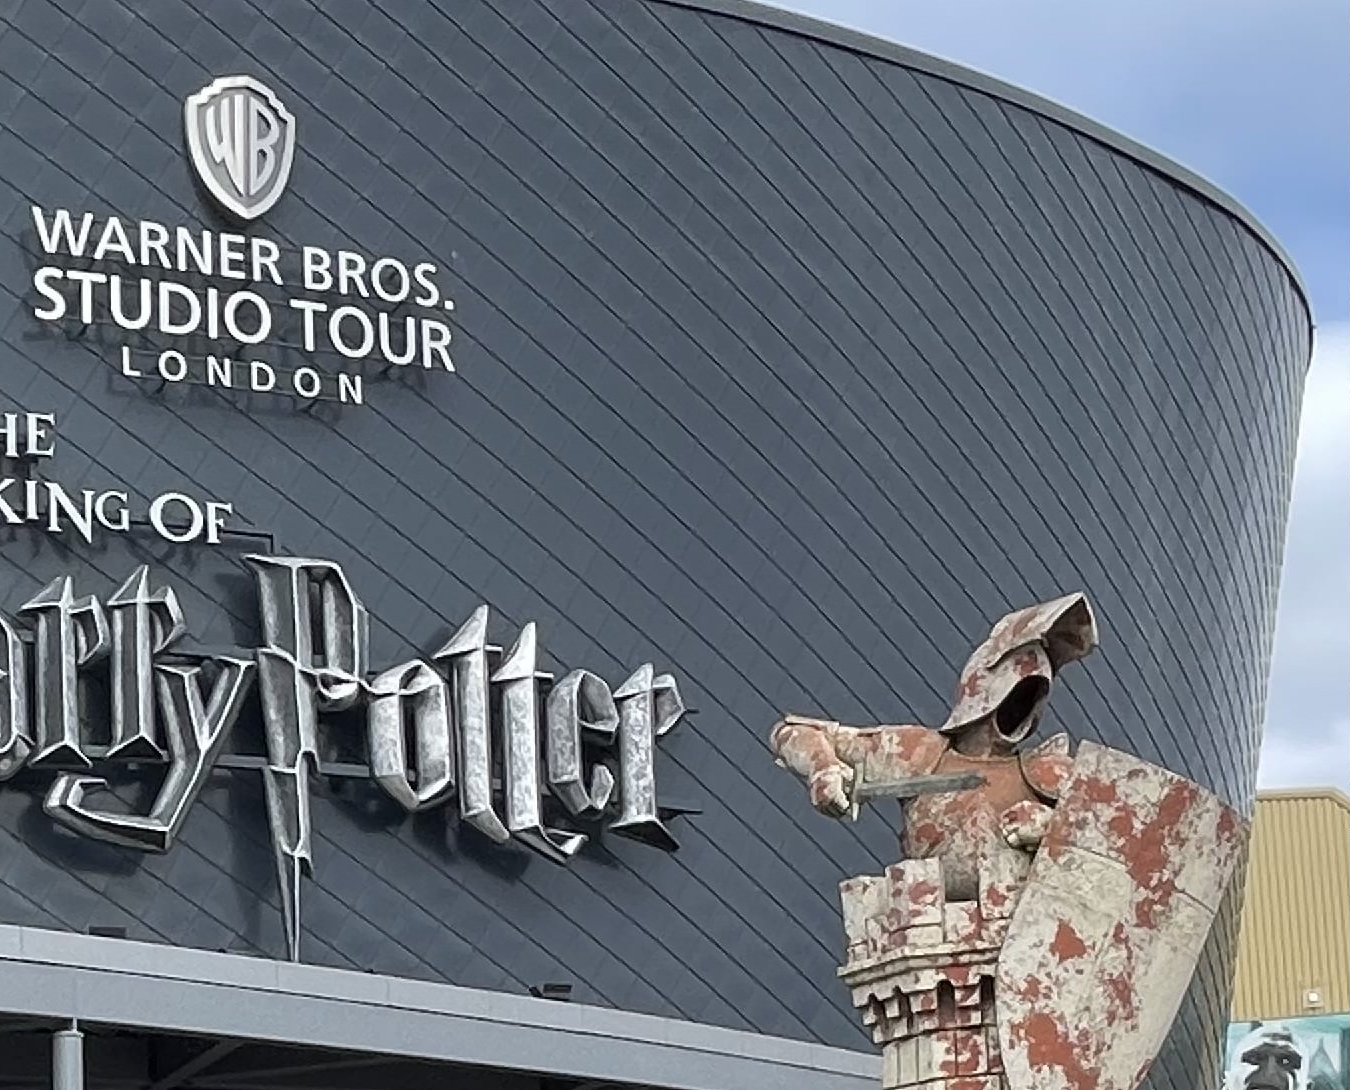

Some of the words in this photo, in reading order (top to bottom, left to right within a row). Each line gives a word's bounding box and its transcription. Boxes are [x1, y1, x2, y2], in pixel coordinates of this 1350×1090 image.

[203, 92, 282, 199] WB
[31, 205, 284, 286] WARNER
[302, 245, 455, 311] BROS.
[33, 266, 272, 345] STUDIO
[289, 298, 456, 372] TOUR
[121, 345, 364, 405] LONDON
[242, 554, 687, 962] Potter
